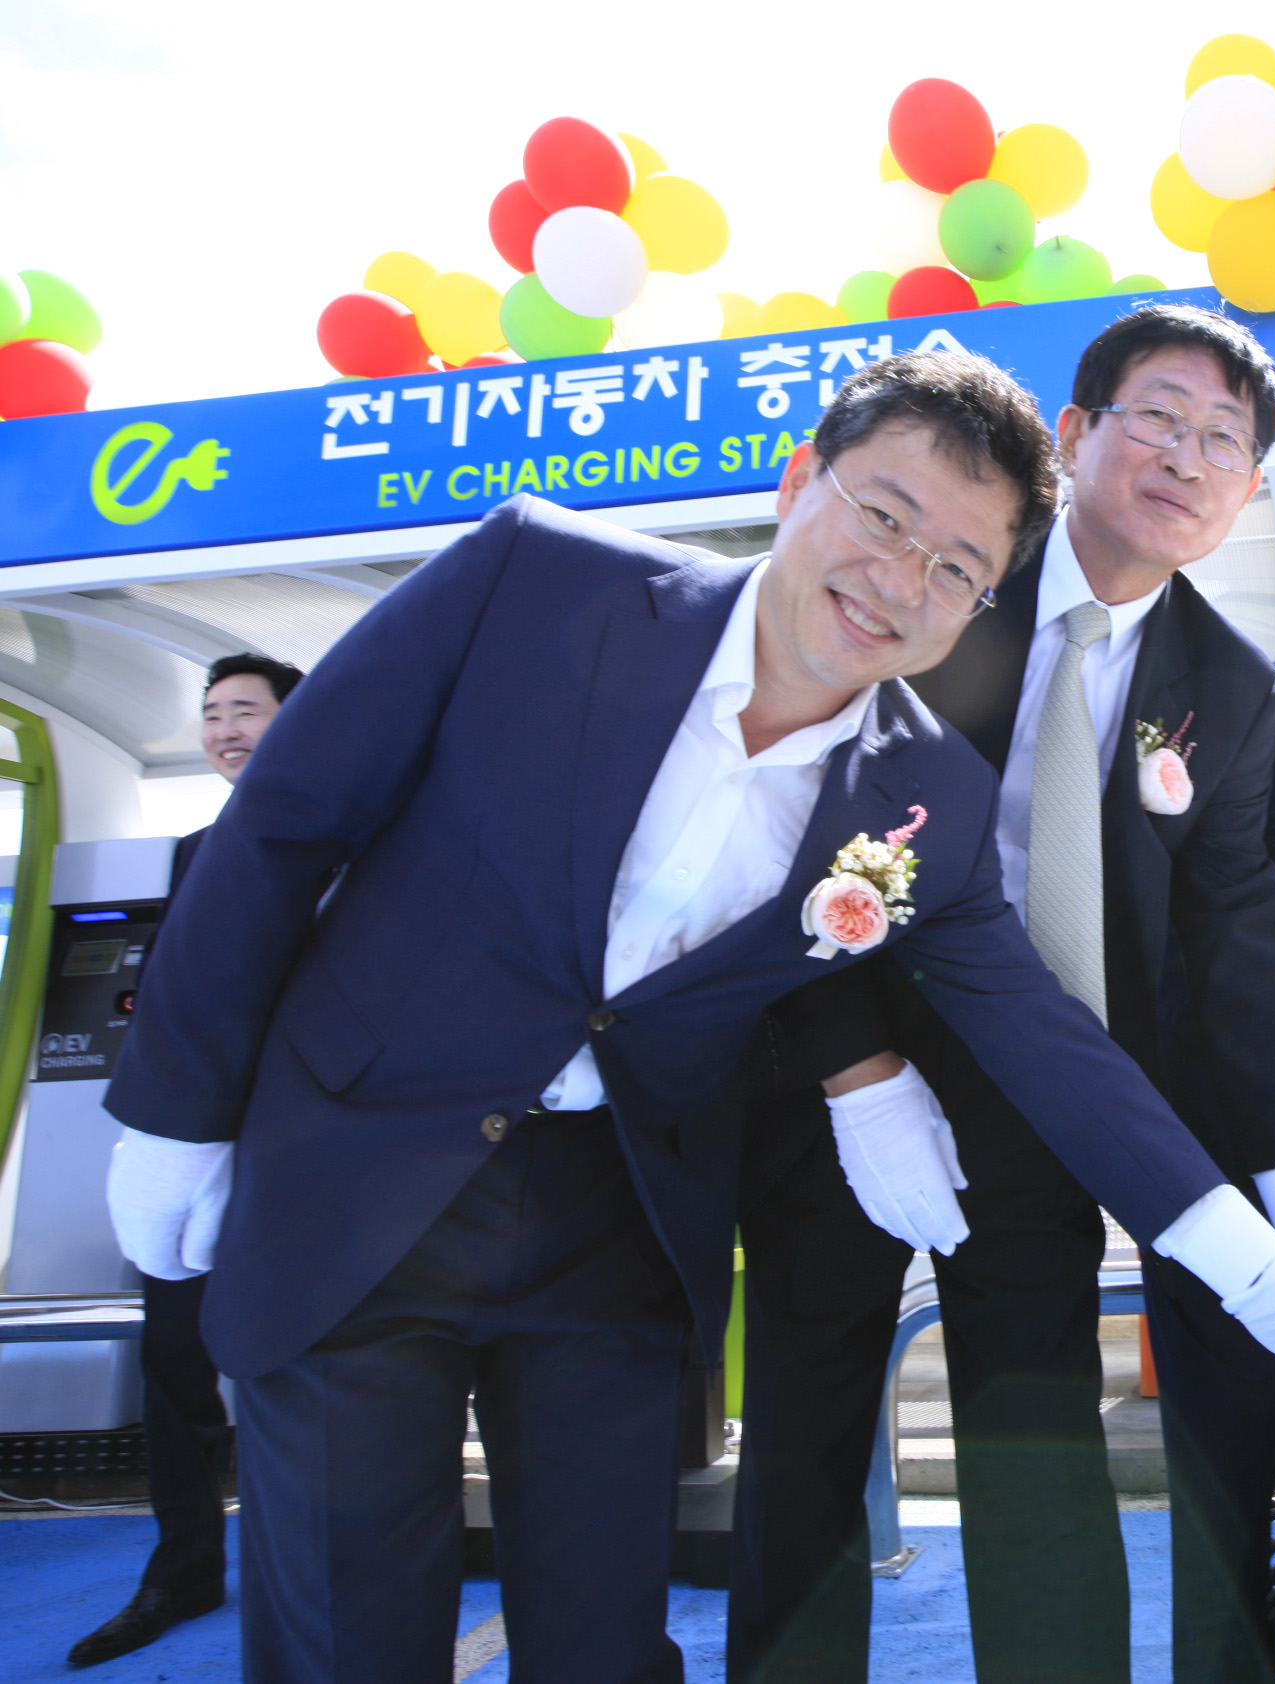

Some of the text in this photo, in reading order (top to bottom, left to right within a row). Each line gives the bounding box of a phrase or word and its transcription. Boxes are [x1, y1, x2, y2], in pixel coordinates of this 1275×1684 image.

[322, 356, 709, 460] 전기자동차
[377, 469, 432, 508] EV
[447, 442, 701, 500] CHARGING
[40, 1054, 105, 1069] CHARGING
[64, 1033, 93, 1053] EV
